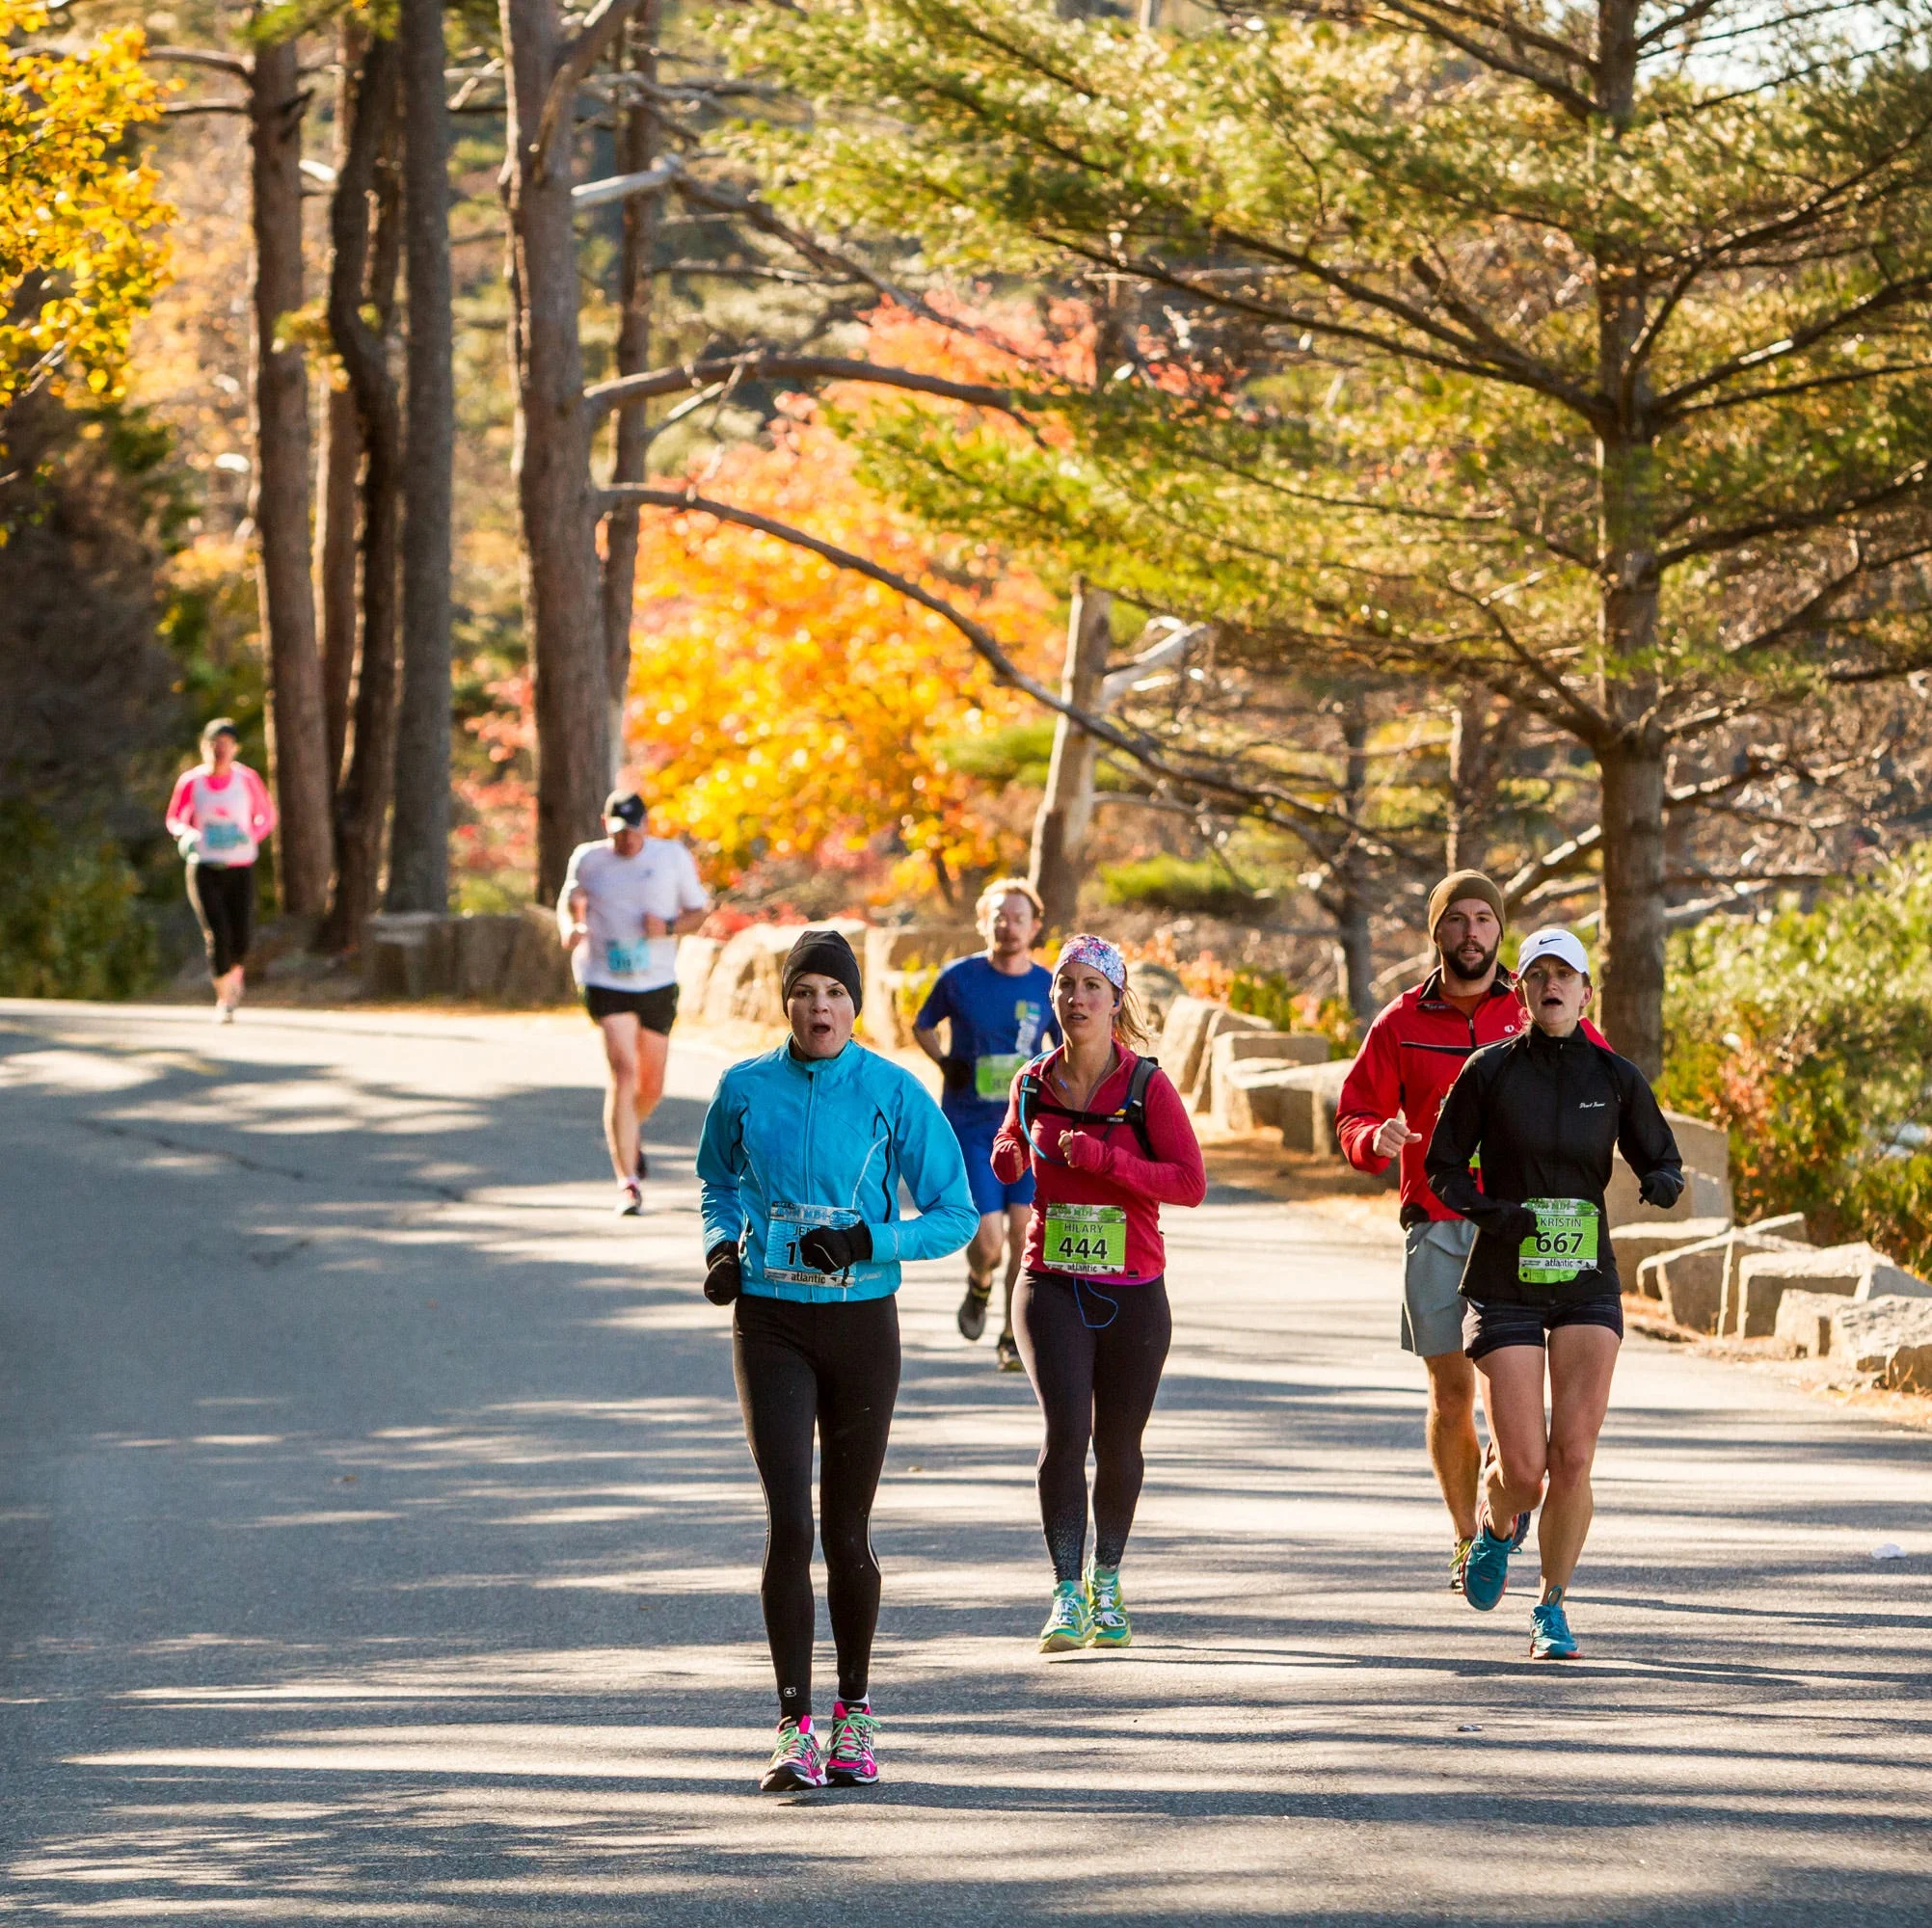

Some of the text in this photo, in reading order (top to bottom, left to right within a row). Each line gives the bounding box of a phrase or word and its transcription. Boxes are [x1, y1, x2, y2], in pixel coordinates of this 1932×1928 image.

[1540, 1218, 1582, 1227] KRISTIN
[1064, 1223, 1104, 1233] HILARY
[1536, 1231, 1584, 1254] 667
[1059, 1237, 1108, 1260] 444
[1067, 1263, 1097, 1273] atlantic
[1544, 1258, 1574, 1268] atlantic
[791, 1272, 825, 1283] atlantic
